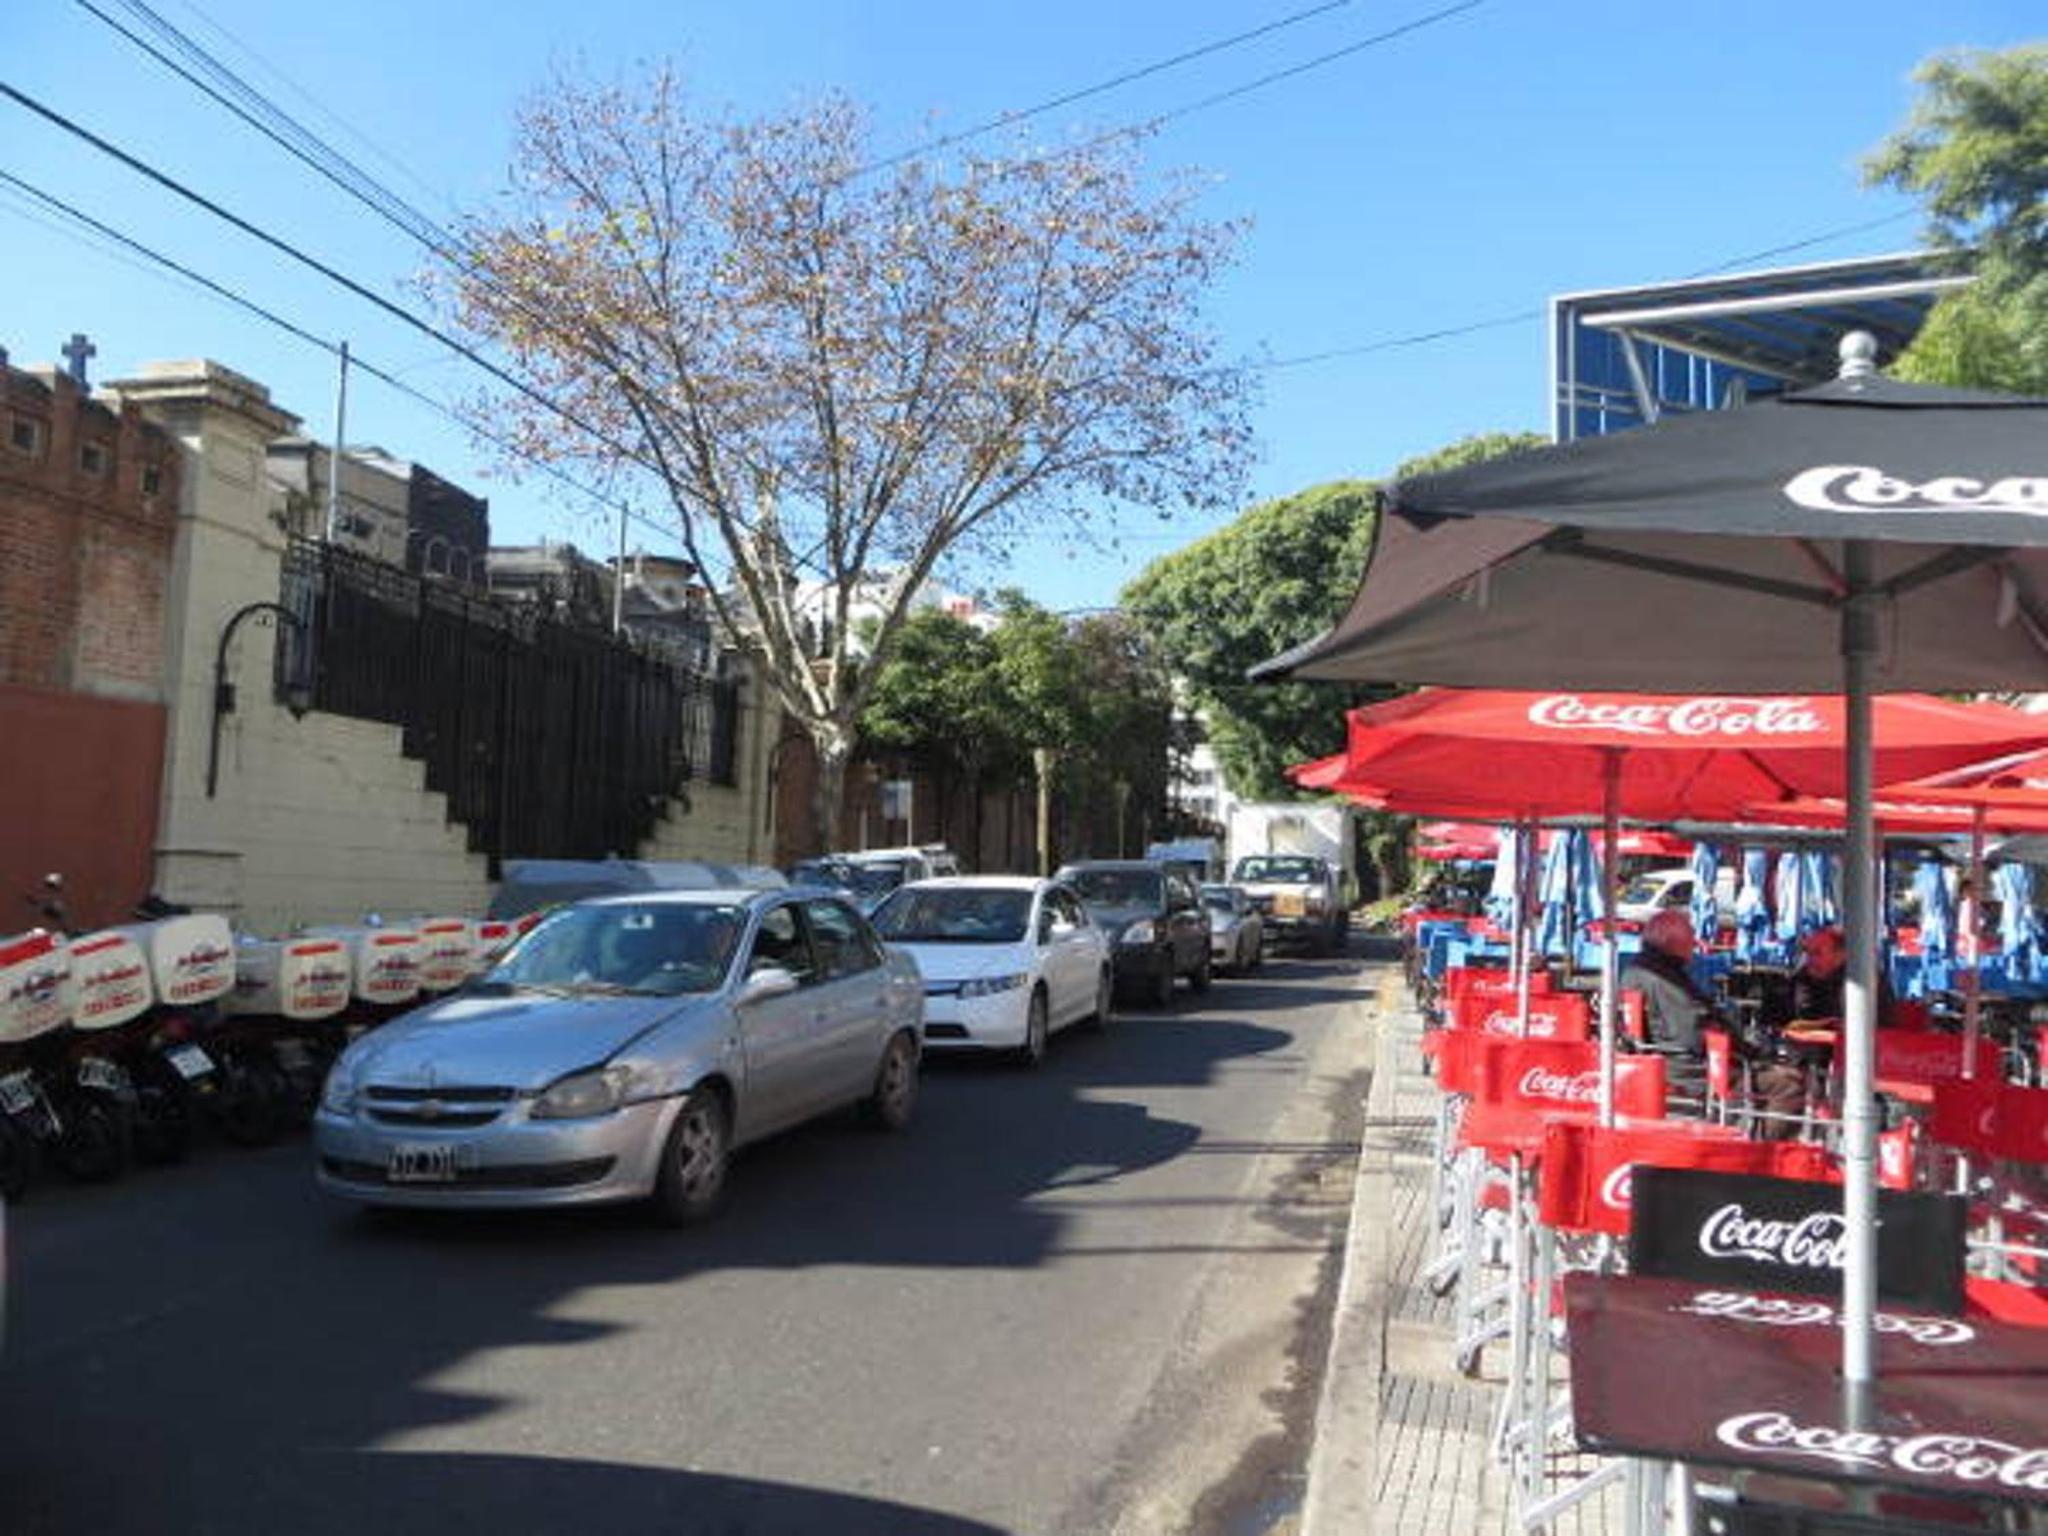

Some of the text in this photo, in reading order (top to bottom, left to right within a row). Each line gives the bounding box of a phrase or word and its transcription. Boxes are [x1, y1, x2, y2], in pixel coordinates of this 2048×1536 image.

[1528, 695, 1829, 735] Coca-Cola
[1700, 1203, 1849, 1268] Coca-Col
[1683, 1292, 1975, 1344] Coc-Cola
